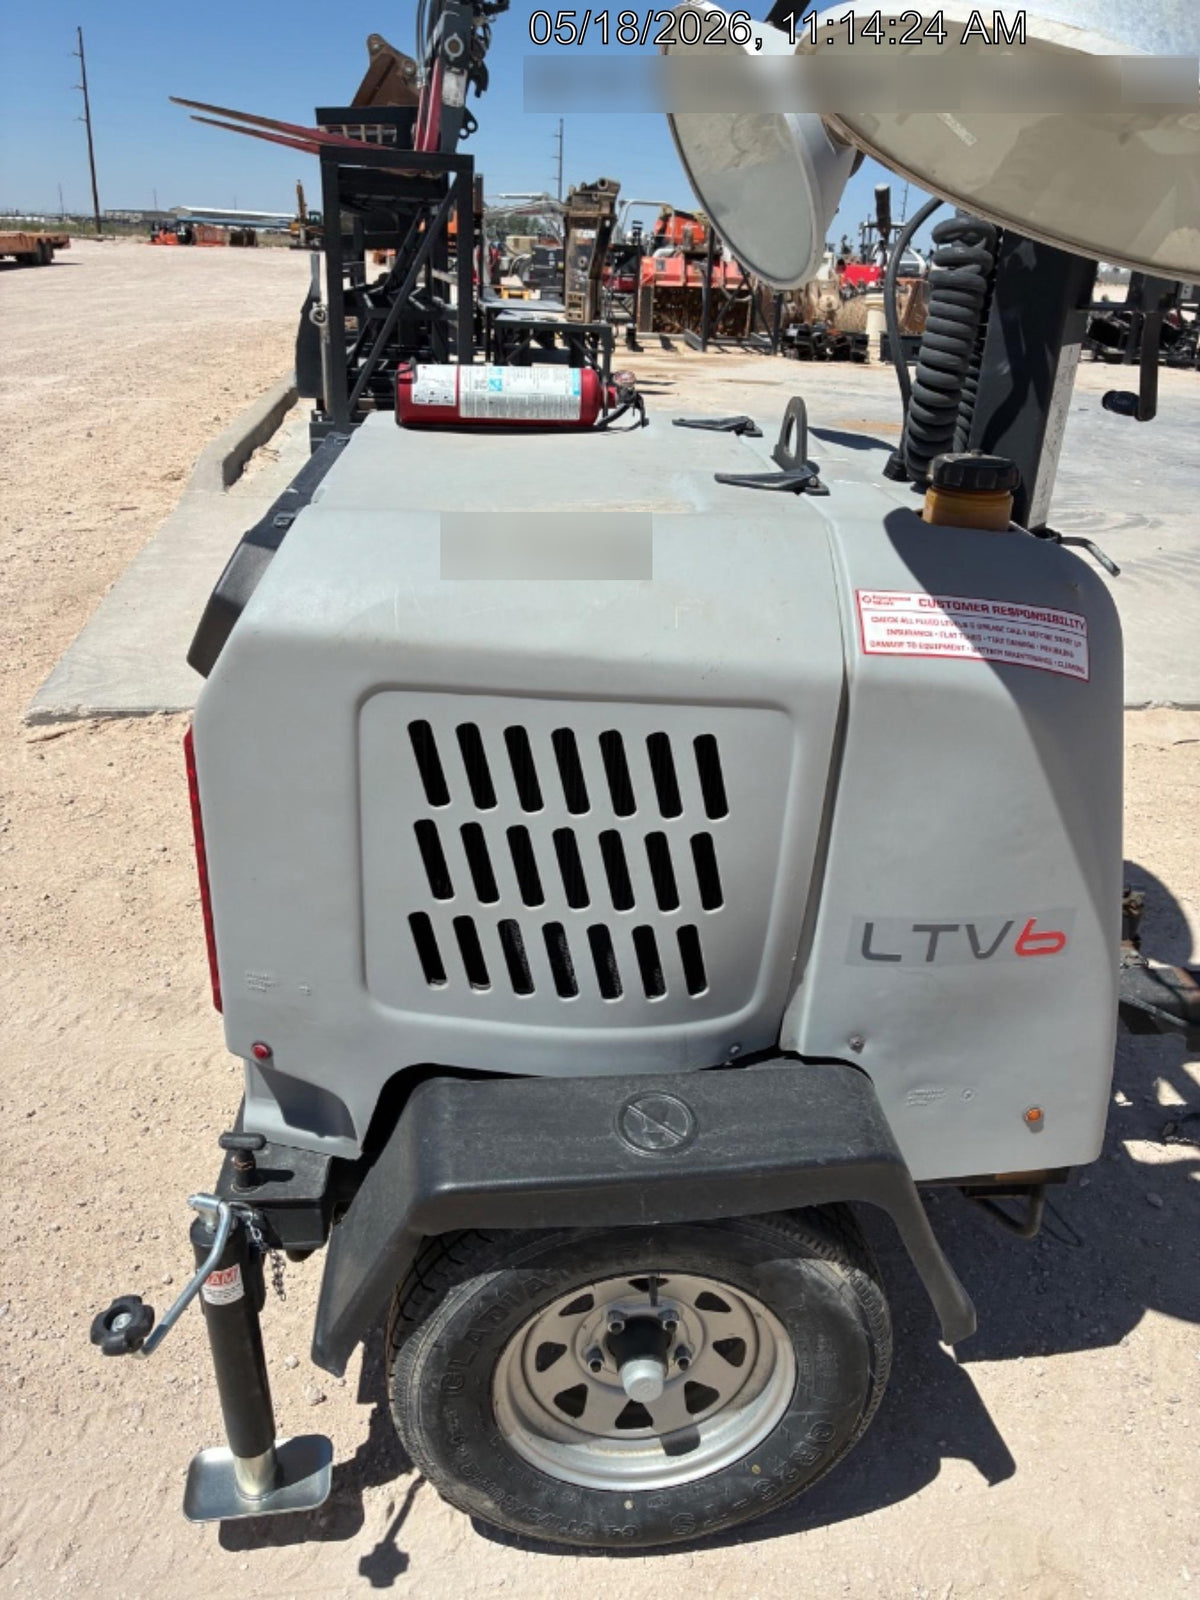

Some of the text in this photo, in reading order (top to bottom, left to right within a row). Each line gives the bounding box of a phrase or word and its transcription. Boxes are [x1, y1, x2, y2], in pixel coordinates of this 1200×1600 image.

[918, 598, 1086, 630] CUSTOMER RESPONSIBILITY
[861, 917, 1067, 963] LTV6
